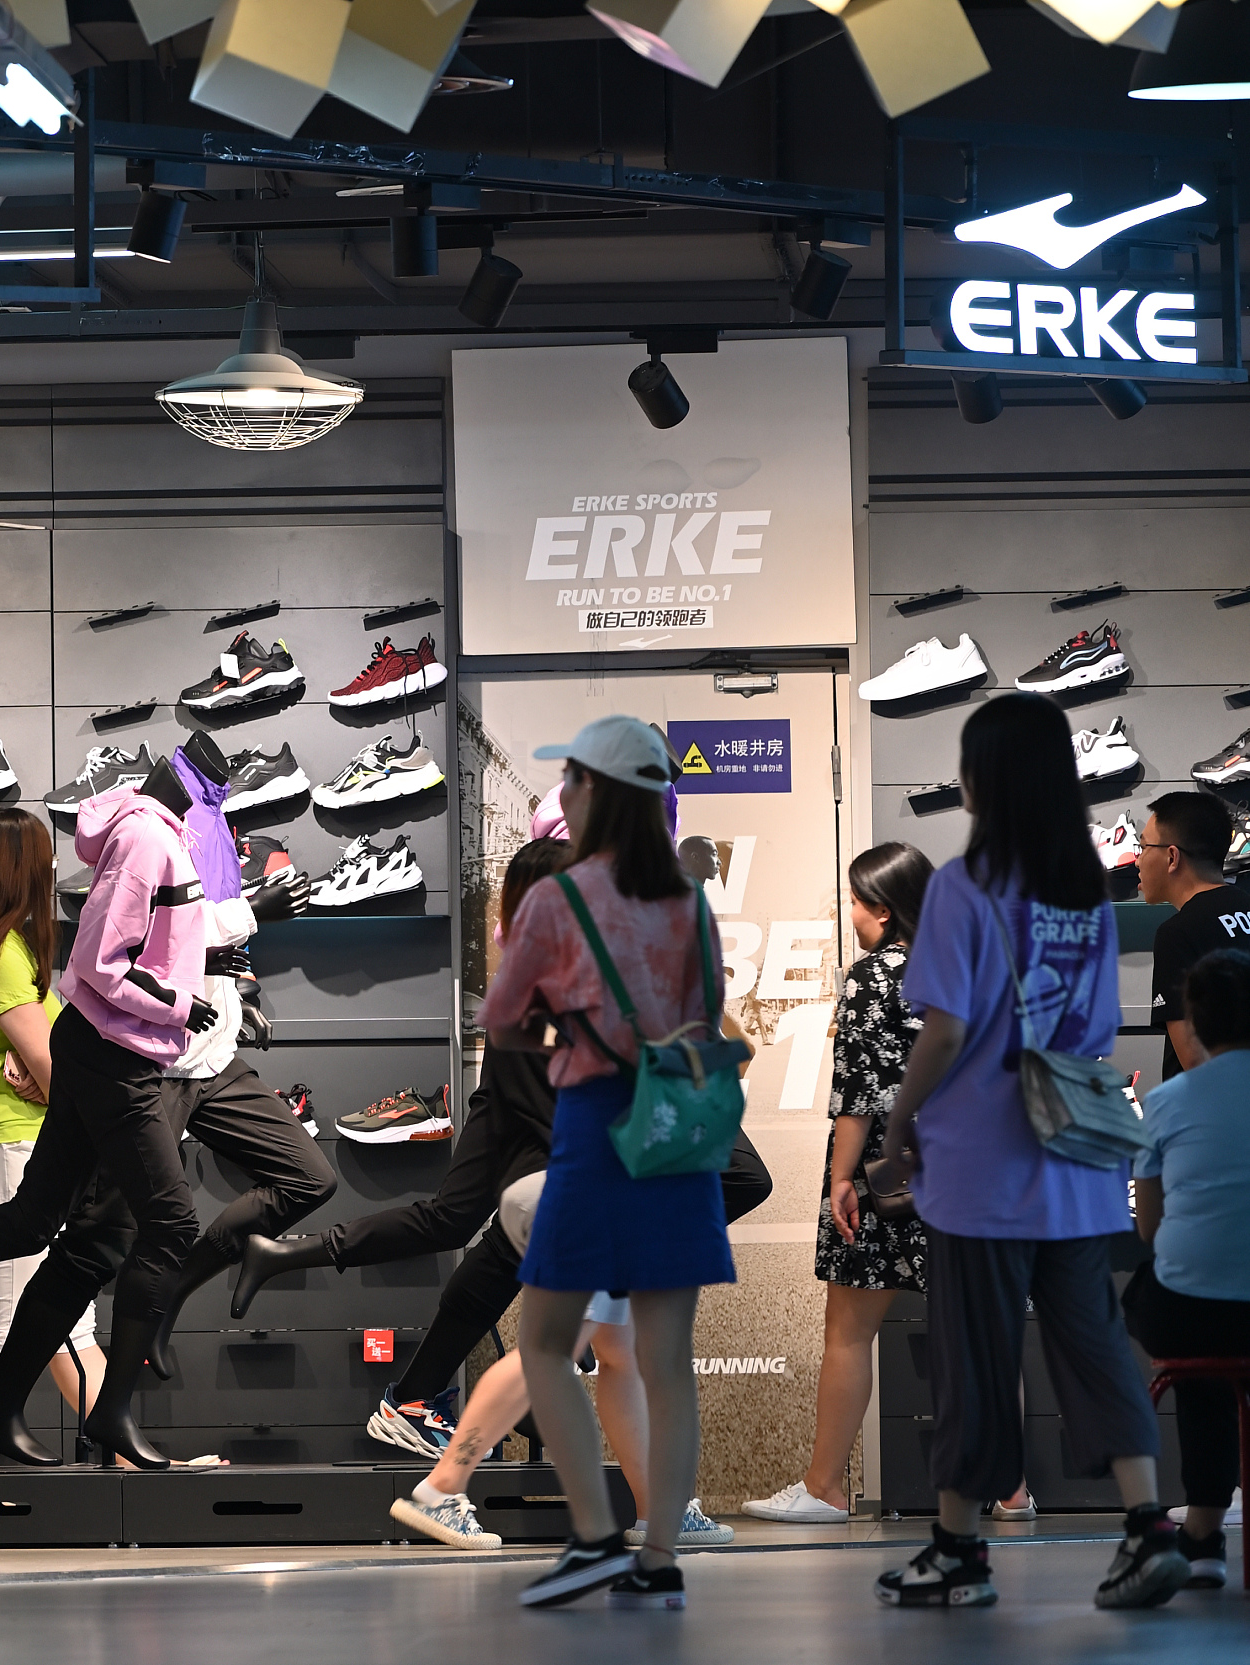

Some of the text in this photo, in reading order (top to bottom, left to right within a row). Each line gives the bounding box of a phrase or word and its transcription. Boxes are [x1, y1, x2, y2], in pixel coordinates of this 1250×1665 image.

[950, 280, 1198, 364] ERKE
[572, 492, 718, 513] ERKE SPORTS
[525, 510, 772, 581] ERKE
[556, 584, 733, 606] RUN TO BE NO.1
[586, 608, 707, 629] 做自己的领跑者
[714, 739, 784, 757] 水暖井房
[1217, 911, 1250, 938] PO
